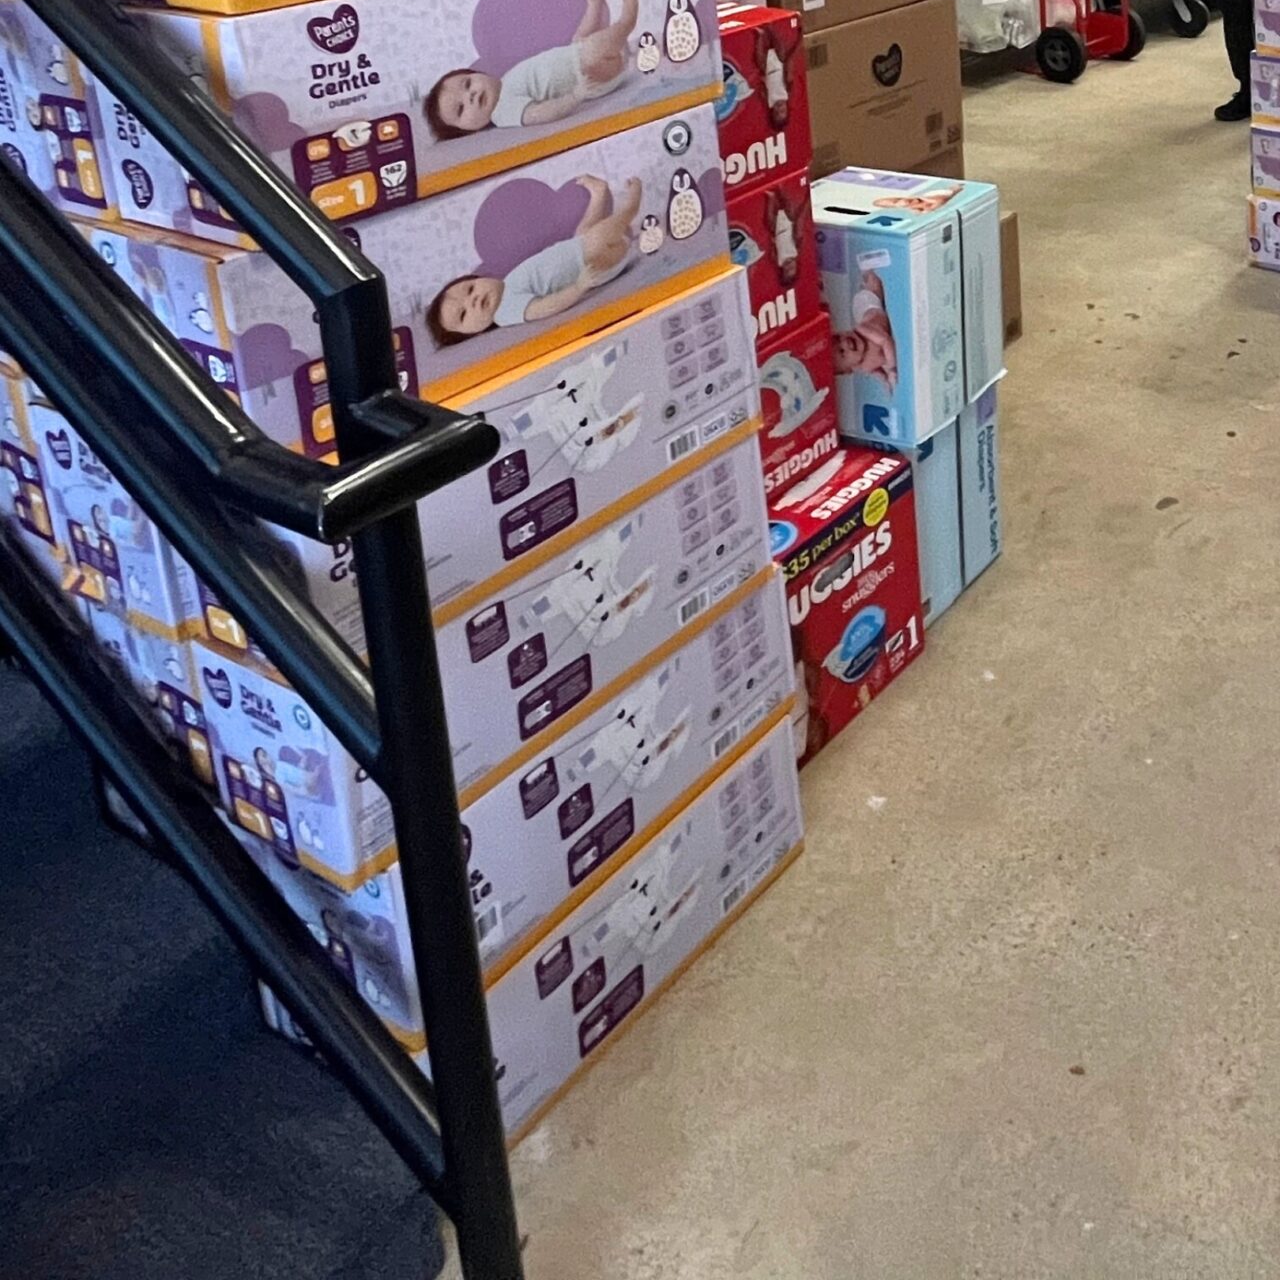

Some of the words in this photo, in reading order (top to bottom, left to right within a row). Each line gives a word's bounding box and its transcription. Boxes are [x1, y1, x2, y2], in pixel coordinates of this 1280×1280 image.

[313, 12, 356, 41] Parent's
[311, 59, 351, 79] Dry
[357, 53, 372, 69] &
[309, 71, 381, 99] Gentle
[328, 92, 367, 109] Diapers
[347, 178, 366, 206] 1
[764, 429, 839, 494] HUGGIES
[976, 430, 986, 492] Diapers
[810, 457, 901, 521] HUGGIES
[811, 535, 834, 561] per
[833, 521, 857, 545] box
[787, 520, 893, 627] UGGIES
[904, 615, 919, 648] 1
